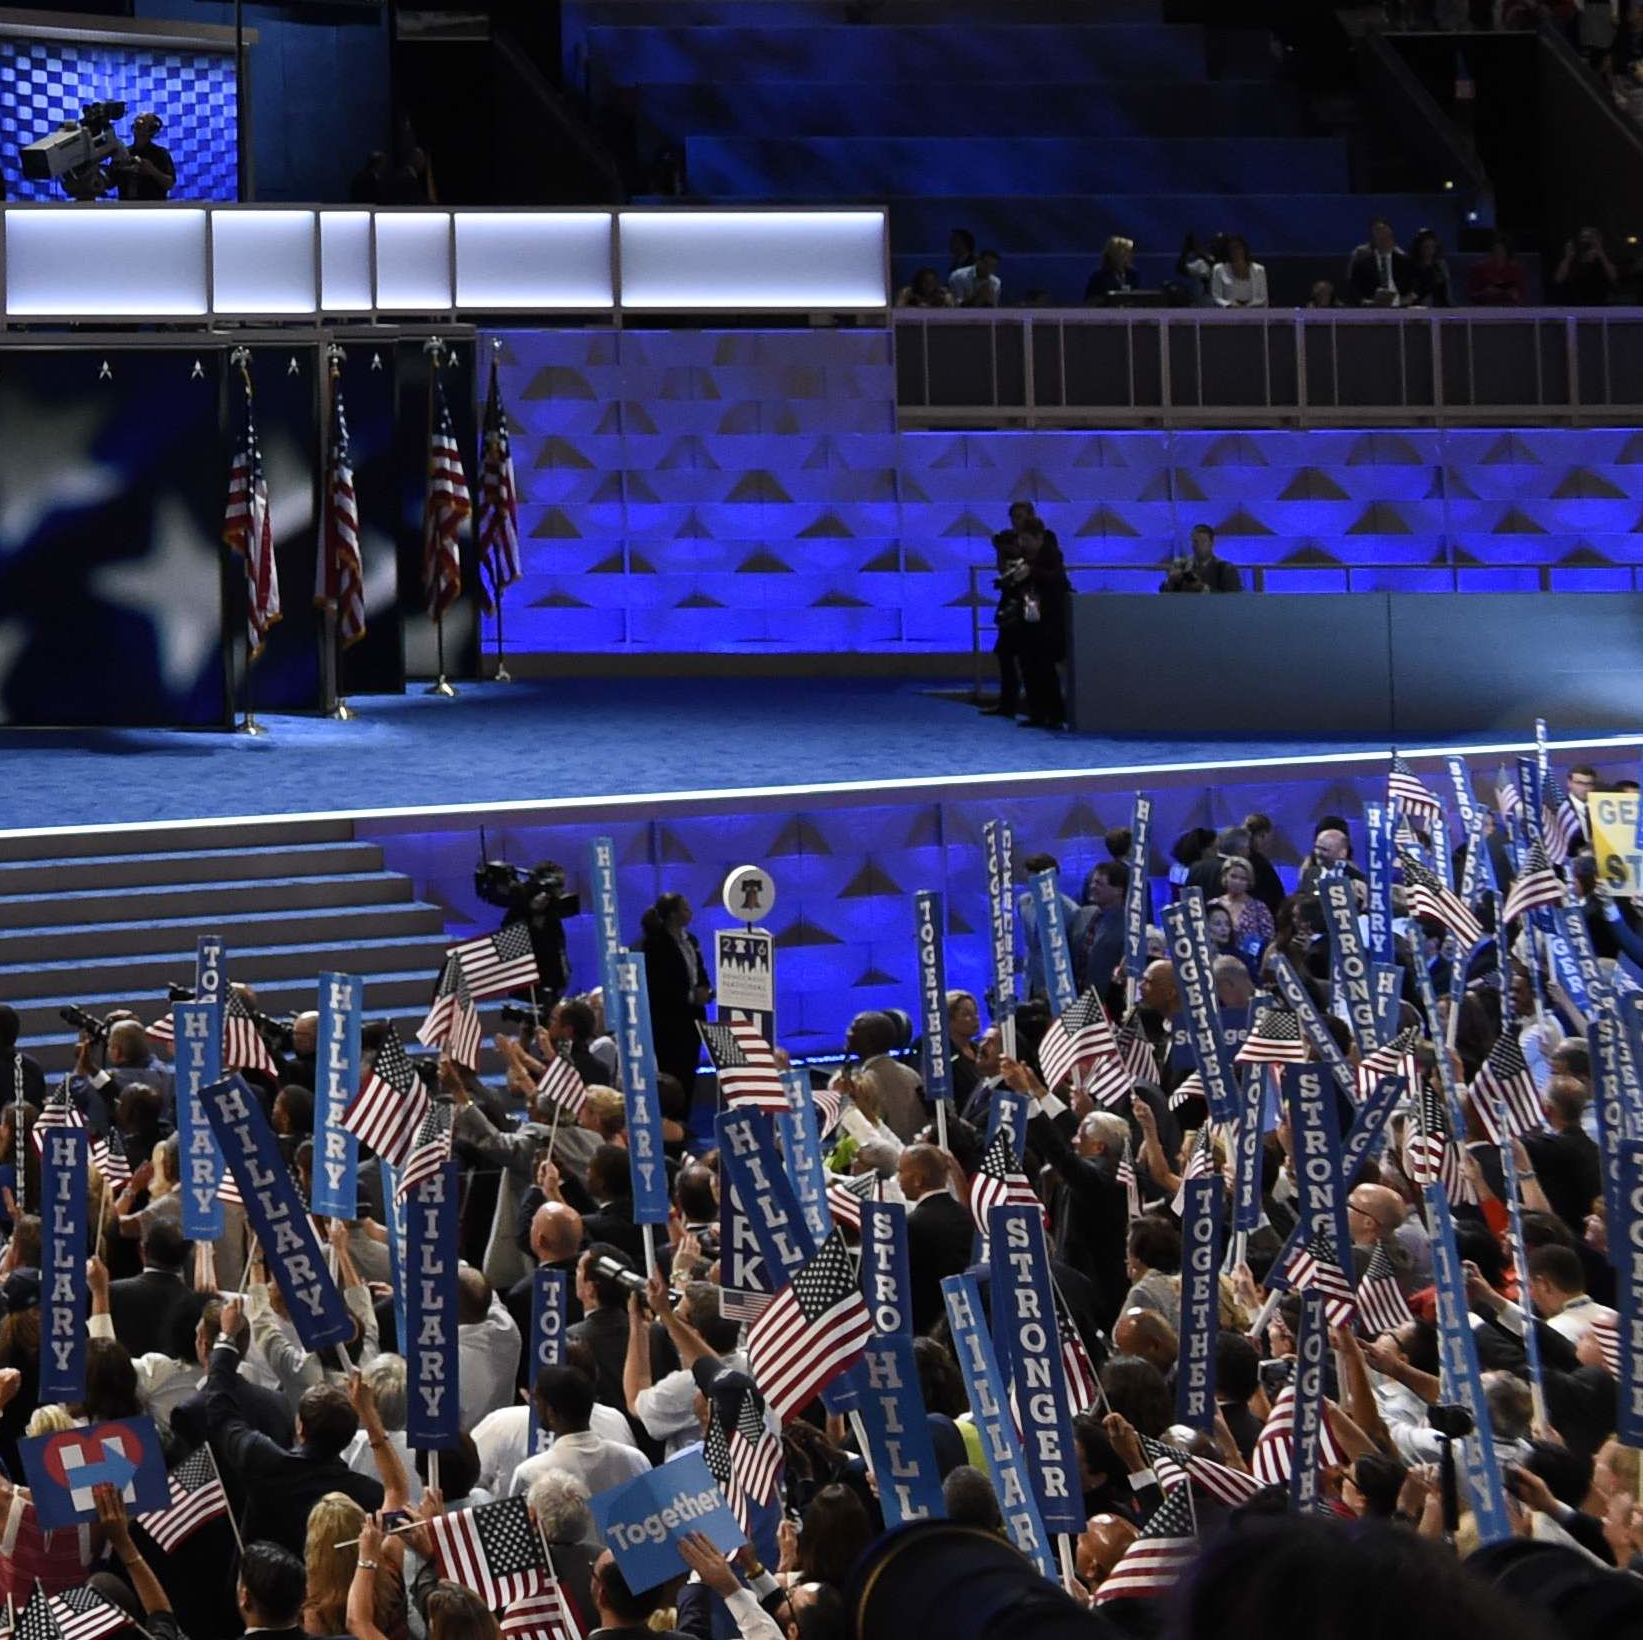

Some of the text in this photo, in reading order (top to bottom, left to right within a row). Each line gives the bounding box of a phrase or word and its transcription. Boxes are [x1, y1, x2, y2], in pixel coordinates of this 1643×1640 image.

[1127, 800, 1150, 957] HILLARY
[1368, 808, 1387, 953] HILLARY
[323, 983, 353, 1190] HILLARY
[618, 963, 654, 1192] HILLARY
[918, 901, 946, 1079] TOGETHER
[1170, 914, 1225, 1098] TOGETHER
[52, 1137, 76, 1371] HILLARY
[214, 1090, 325, 1316] HILLARY
[417, 1174, 446, 1418] HILLARY
[1187, 1188, 1216, 1417] TOGETHER
[1005, 1217, 1070, 1498] STRONGER
[607, 1491, 723, 1552] Together
